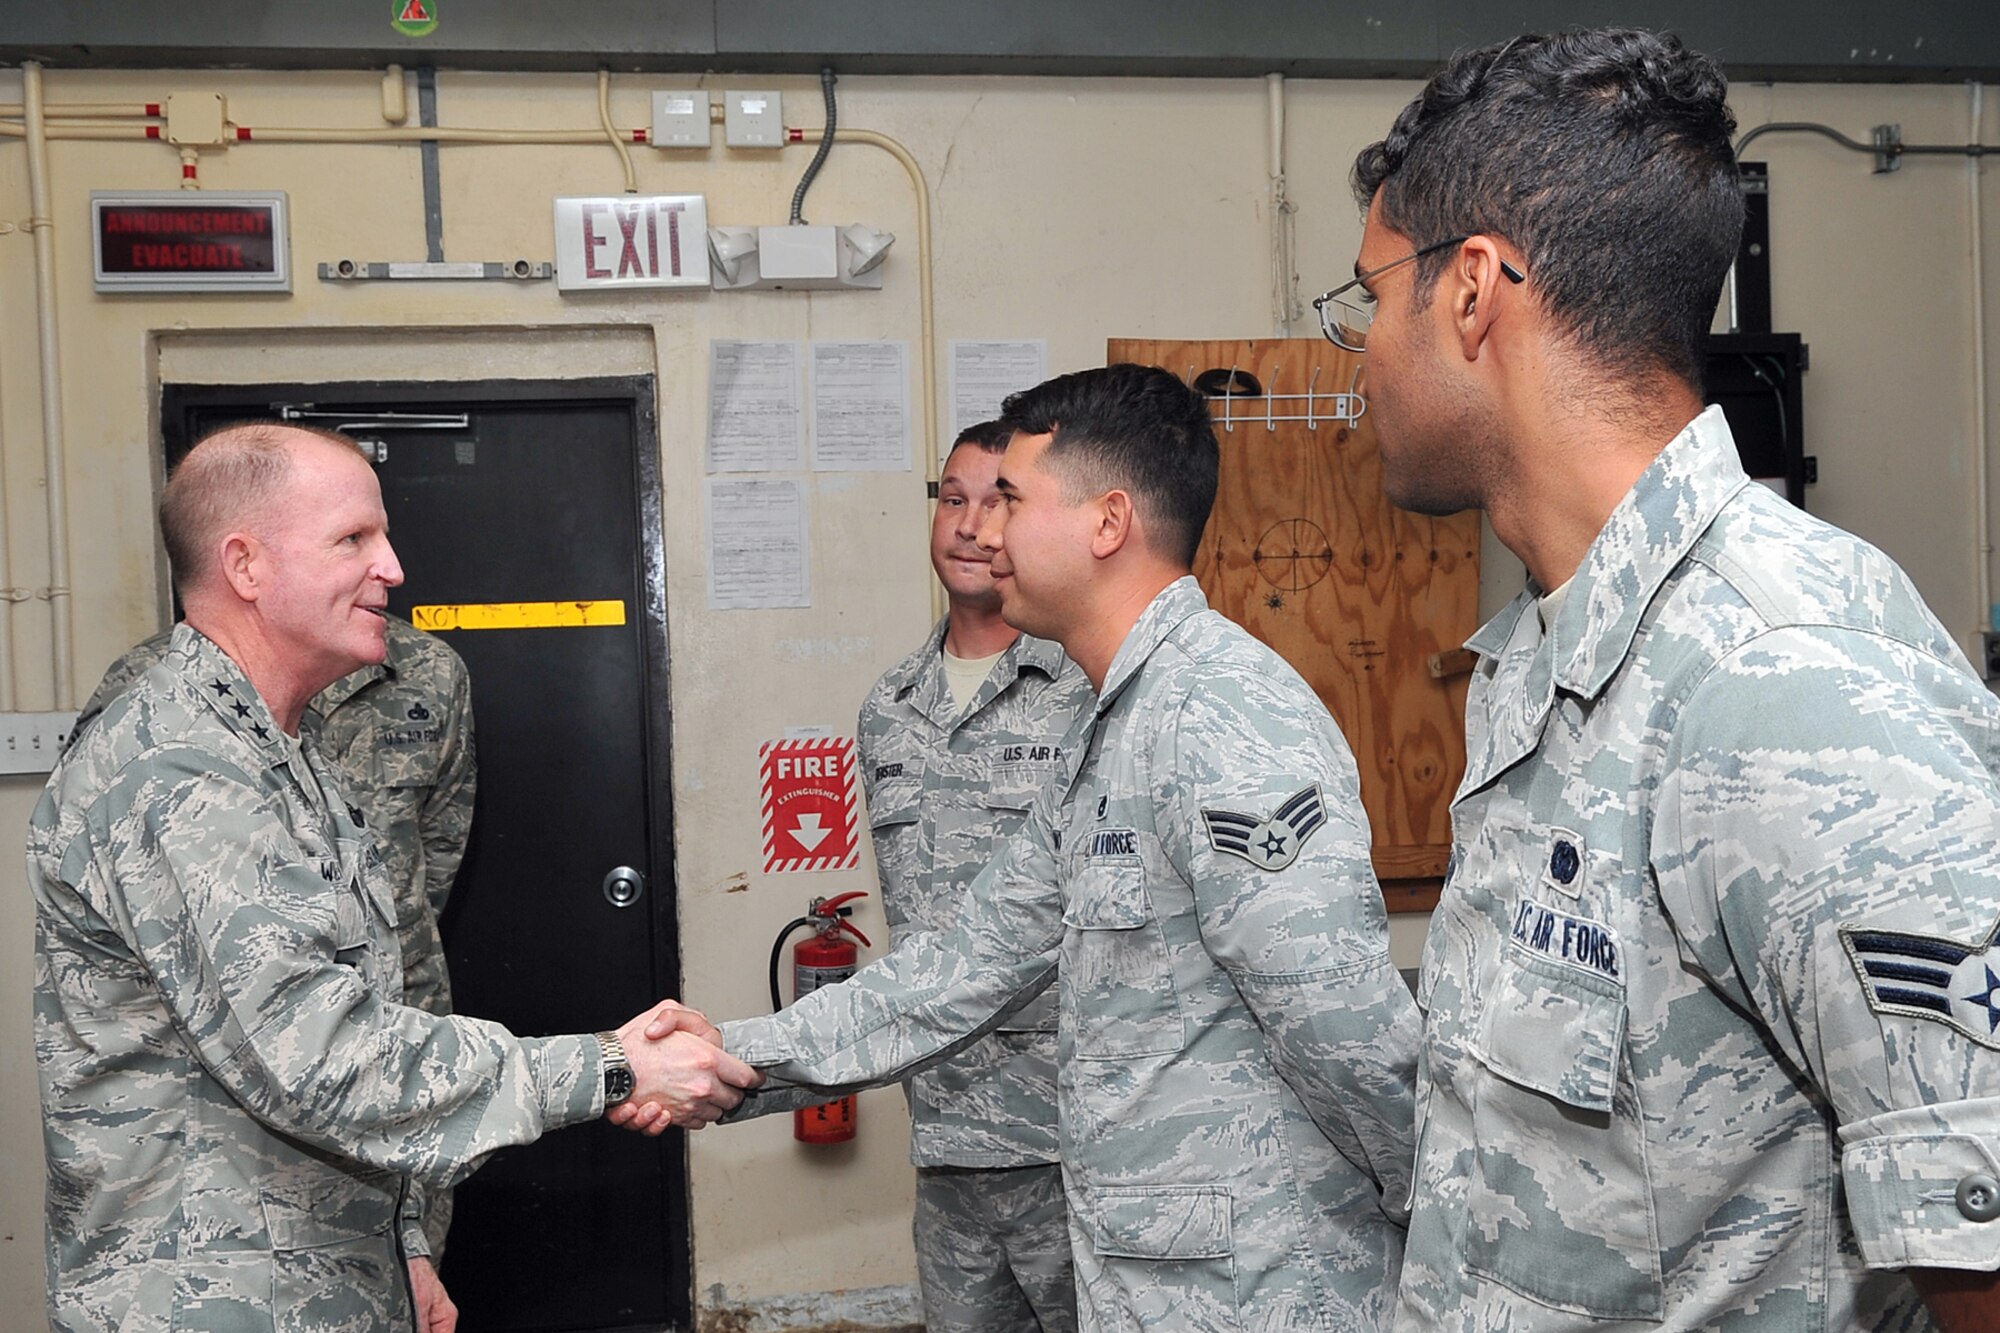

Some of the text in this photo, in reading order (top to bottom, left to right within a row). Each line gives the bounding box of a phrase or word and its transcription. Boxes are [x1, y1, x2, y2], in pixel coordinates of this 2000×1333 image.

[107, 211, 266, 233] ANNOUNCEMENT
[582, 202, 685, 279] EXIT
[132, 243, 244, 267] EVACUATE
[415, 606, 459, 628] NOT
[1003, 746, 1025, 761] U.S.
[1028, 746, 1050, 761] AIR
[777, 756, 838, 780] FIRE
[777, 787, 841, 805] EXTINGUISHER
[1100, 832, 1135, 855] FORCE
[1530, 911, 1554, 952] AIR
[1562, 920, 1619, 976] FORCE
